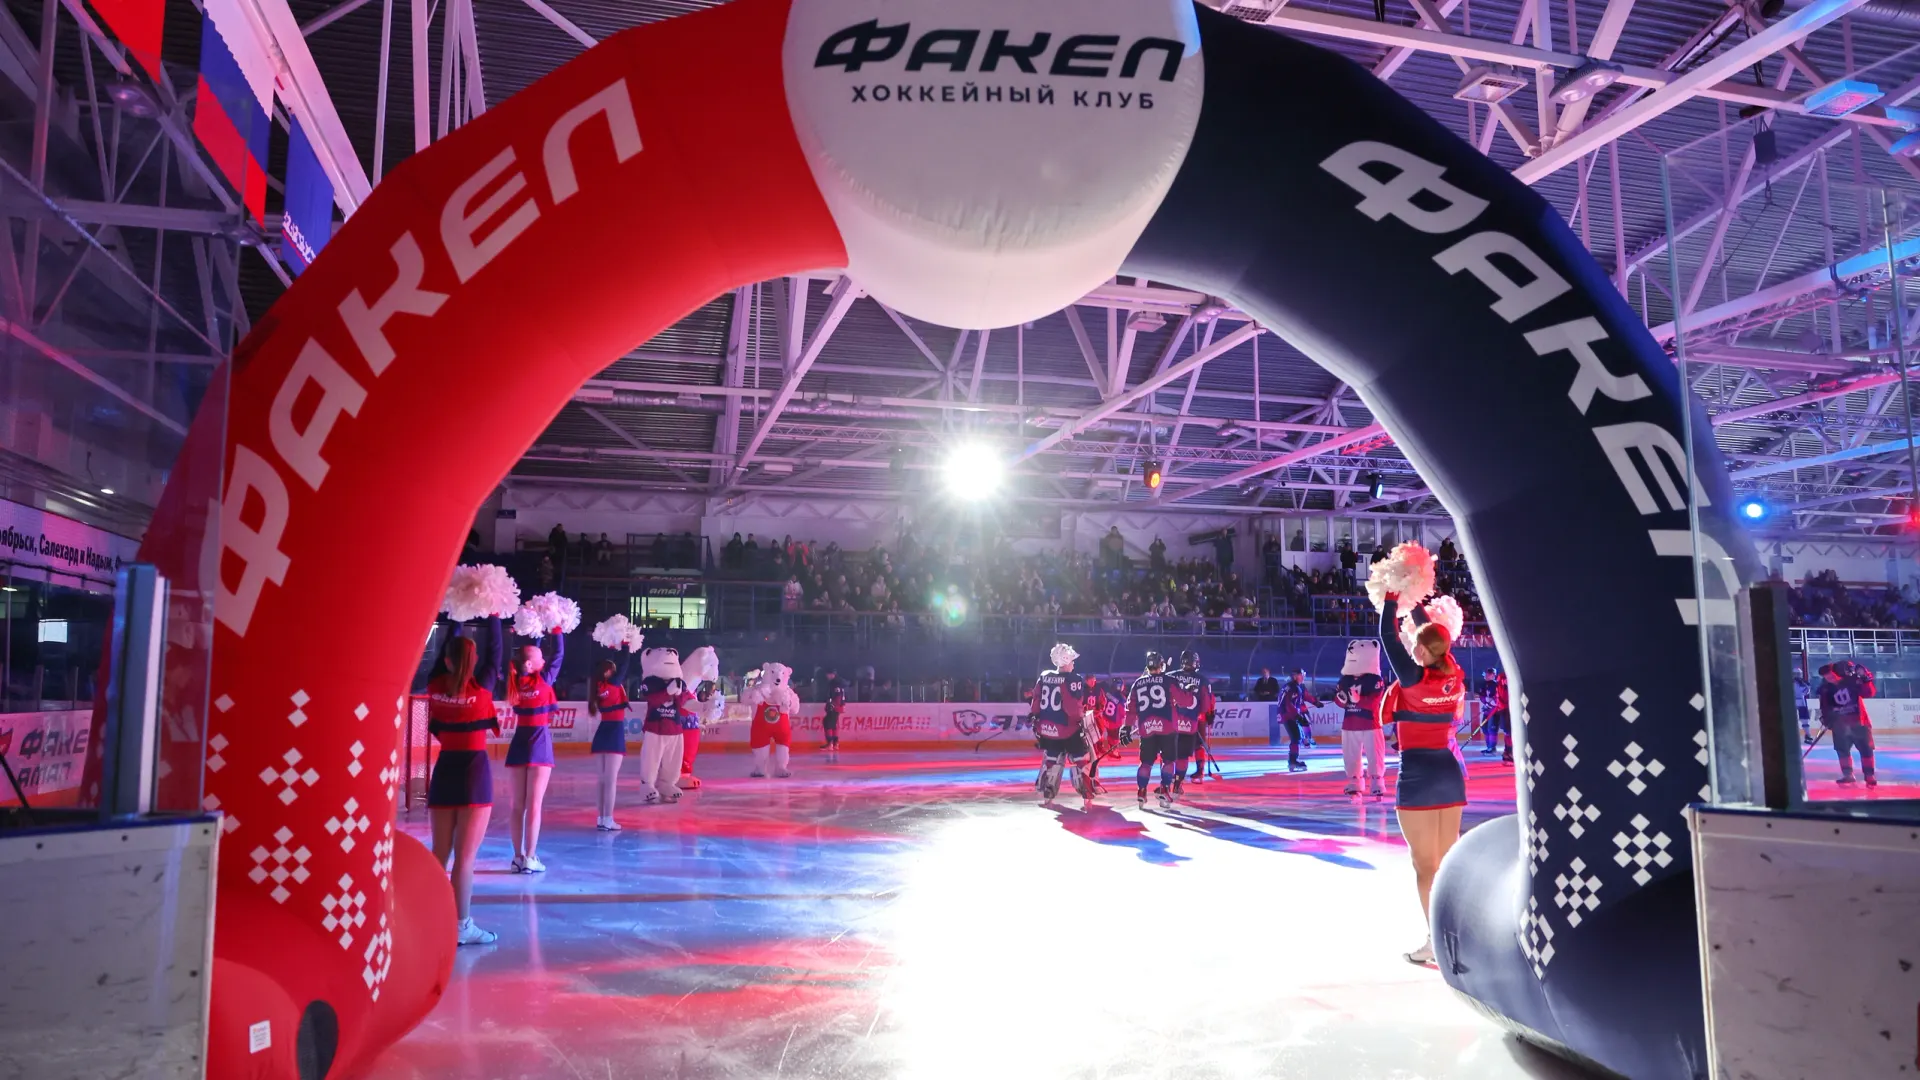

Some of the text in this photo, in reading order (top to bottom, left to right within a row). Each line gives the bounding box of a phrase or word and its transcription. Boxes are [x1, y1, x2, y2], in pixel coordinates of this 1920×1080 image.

[814, 18, 1186, 82] ФАКЕЛ
[851, 81, 1155, 110] ХОККЕЙНЫЙ КЛУБ
[199, 78, 643, 638] ФАКЕЛ
[1319, 140, 1742, 625] ФАКЕЛ
[39, 533, 79, 567] Салехард
[1136, 684, 1167, 712] 59
[854, 716, 913, 731] МАШИНА
[20, 727, 90, 761] ФАКЕ
